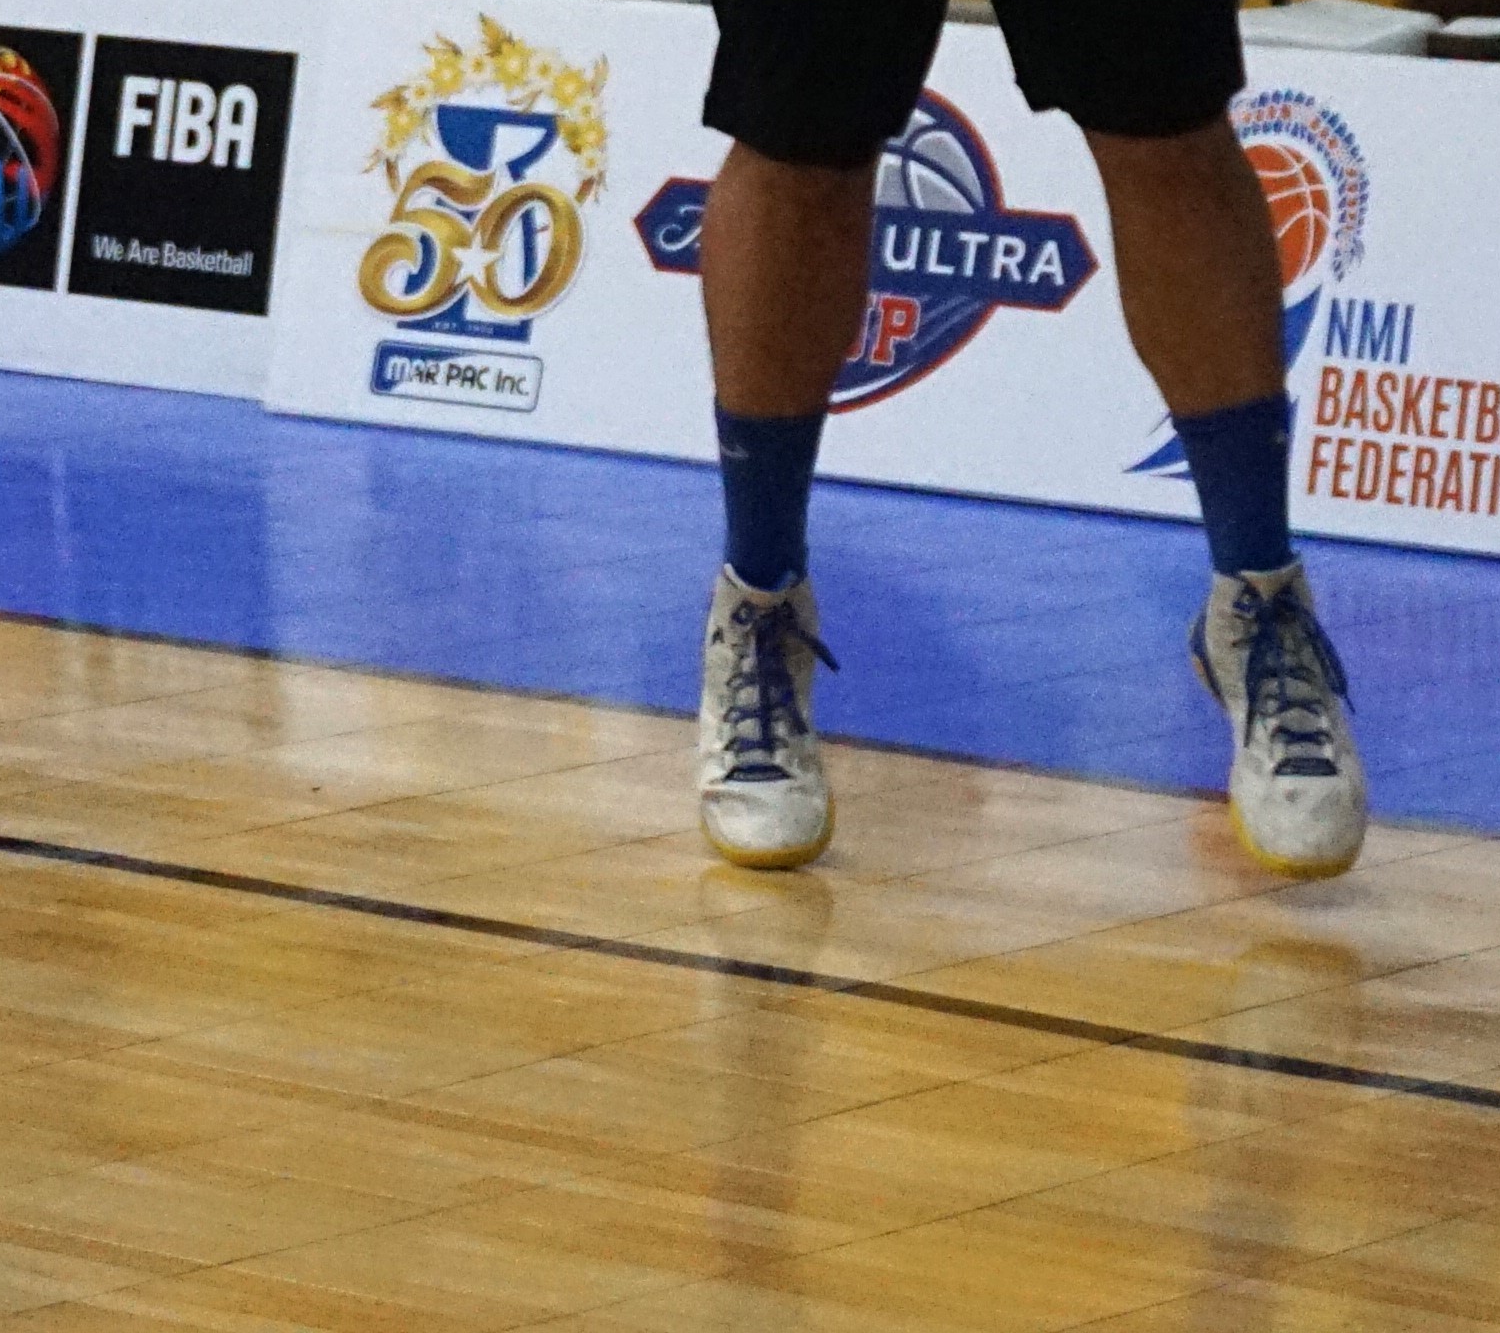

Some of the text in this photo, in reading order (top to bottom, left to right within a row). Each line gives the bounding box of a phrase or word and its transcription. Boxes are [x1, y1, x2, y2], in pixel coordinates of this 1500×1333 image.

[113, 74, 259, 170] FIBA
[91, 234, 254, 277] We Are Basketball
[355, 158, 588, 320] 50
[883, 225, 1066, 287] ULTRA
[1324, 297, 1416, 366] NMI
[446, 362, 490, 390] PAC
[494, 367, 530, 396] Inc.
